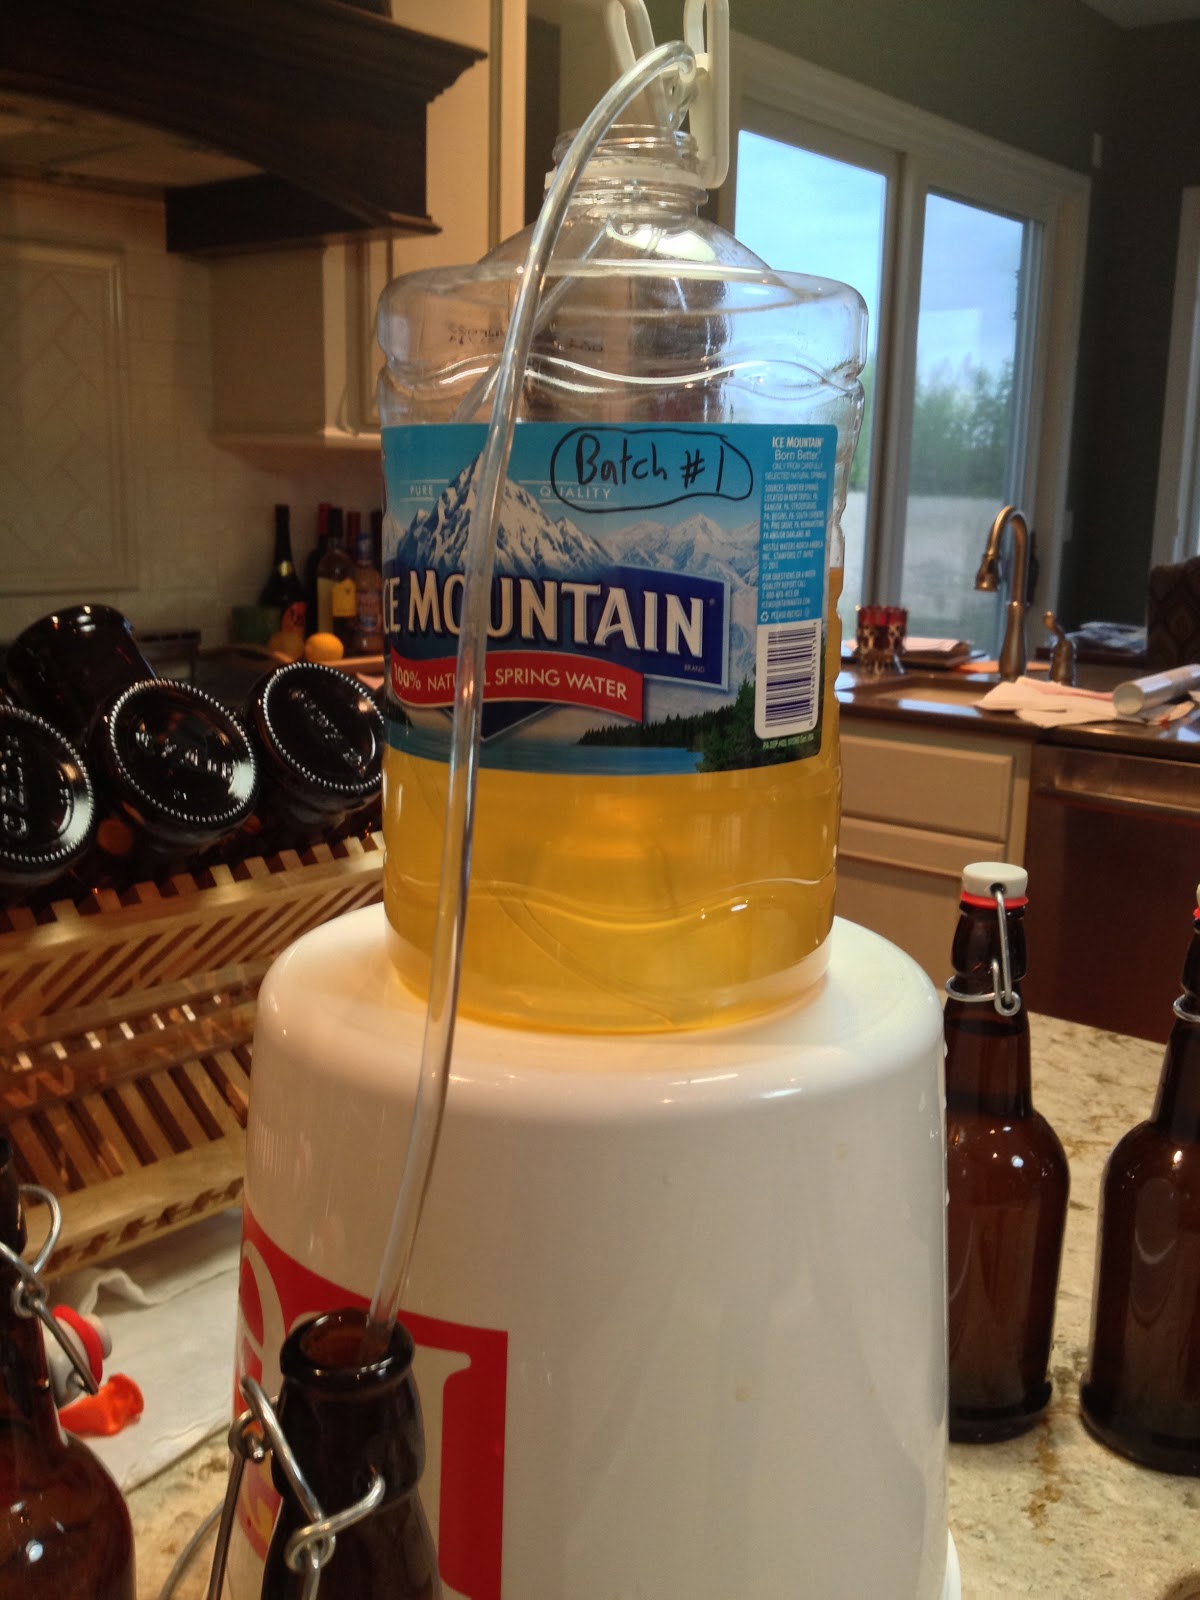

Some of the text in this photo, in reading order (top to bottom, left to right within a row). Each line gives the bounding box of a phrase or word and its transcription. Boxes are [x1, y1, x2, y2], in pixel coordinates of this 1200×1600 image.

[772, 436, 785, 448] ICE
[575, 432, 667, 485] Batch
[774, 449, 795, 460] Born
[410, 485, 434, 497] PURE
[382, 569, 704, 659] CE MOUNTAIN
[684, 663, 705, 674] BRAND
[393, 662, 627, 701] 100% NATL SPRING WATER
